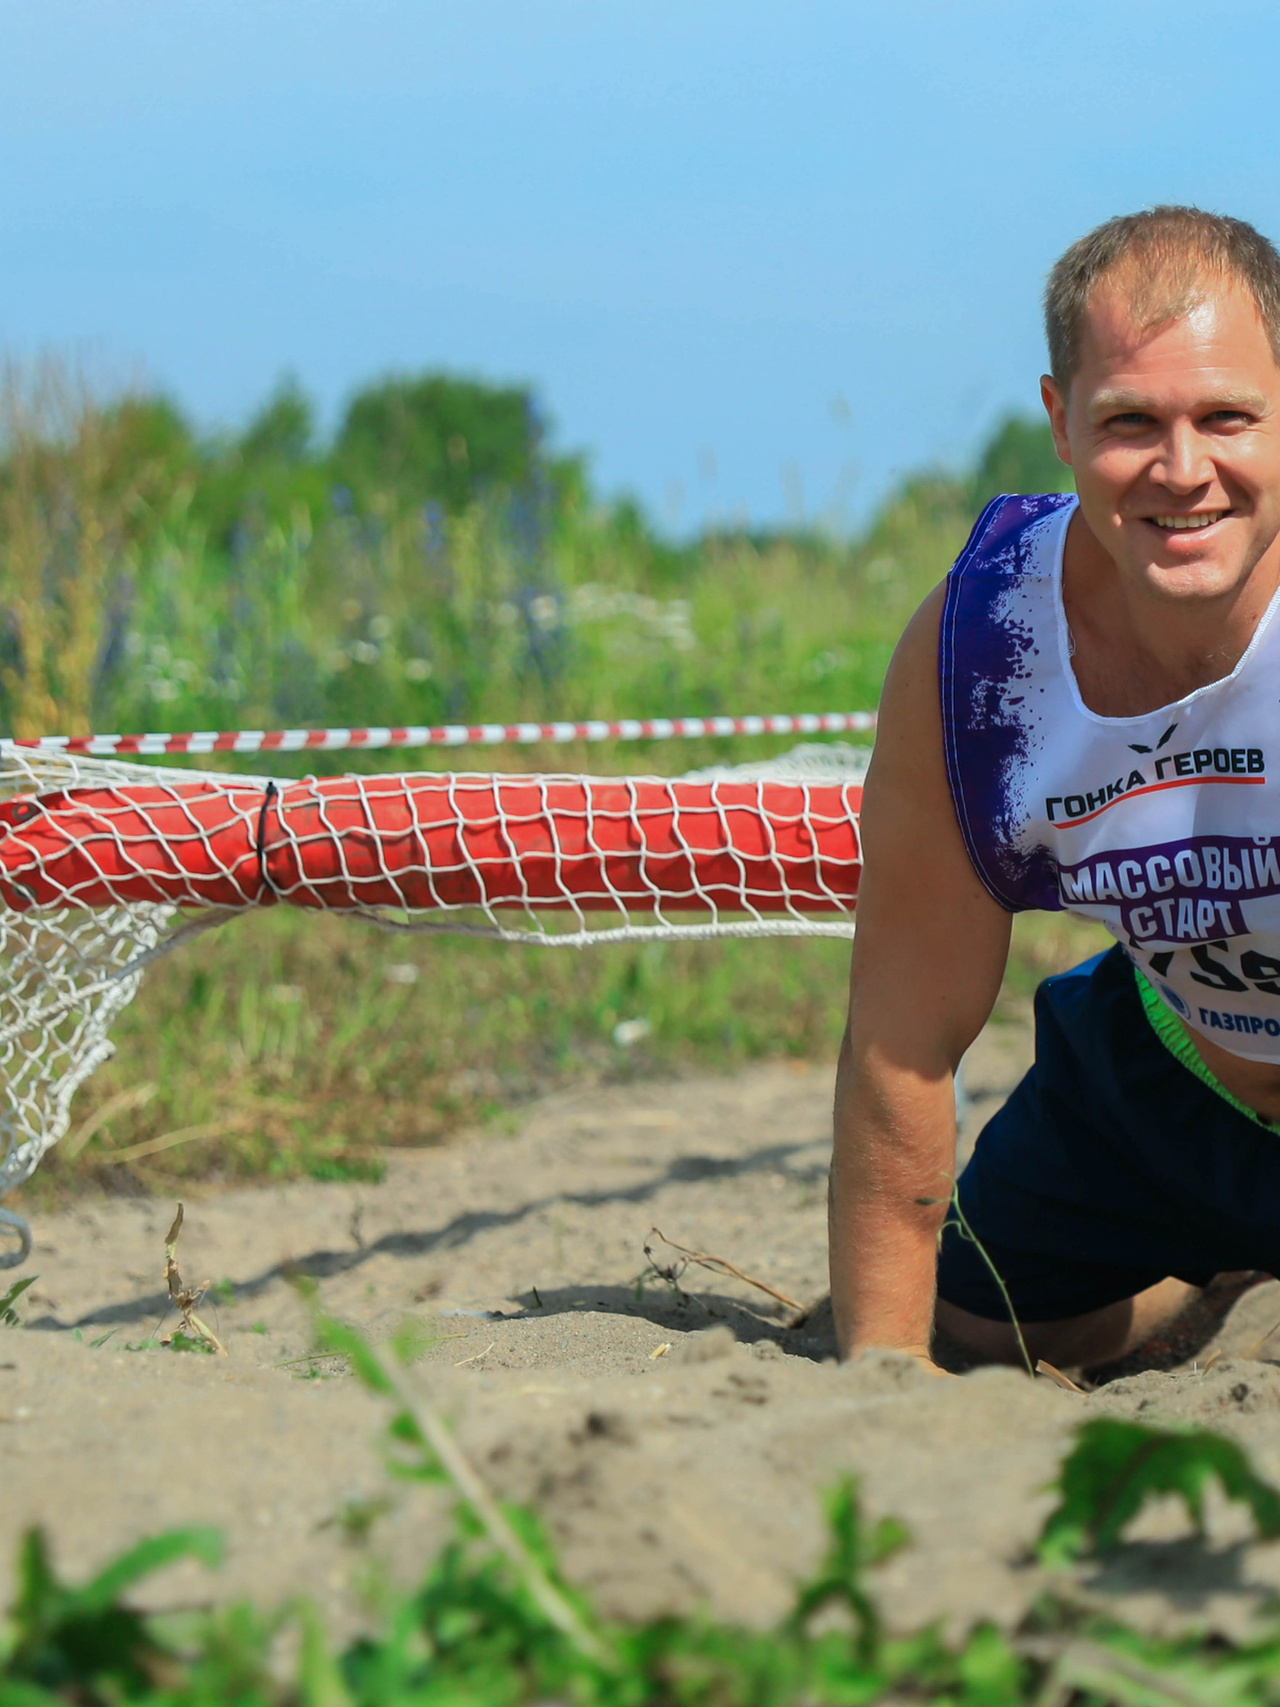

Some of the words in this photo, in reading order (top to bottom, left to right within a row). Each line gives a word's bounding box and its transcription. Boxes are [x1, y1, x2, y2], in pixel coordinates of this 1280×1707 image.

[1046, 769, 1147, 821] ГОНКА
[1154, 748, 1265, 781] ГЕРОЕВ
[1129, 899, 1233, 939] СТАРТ
